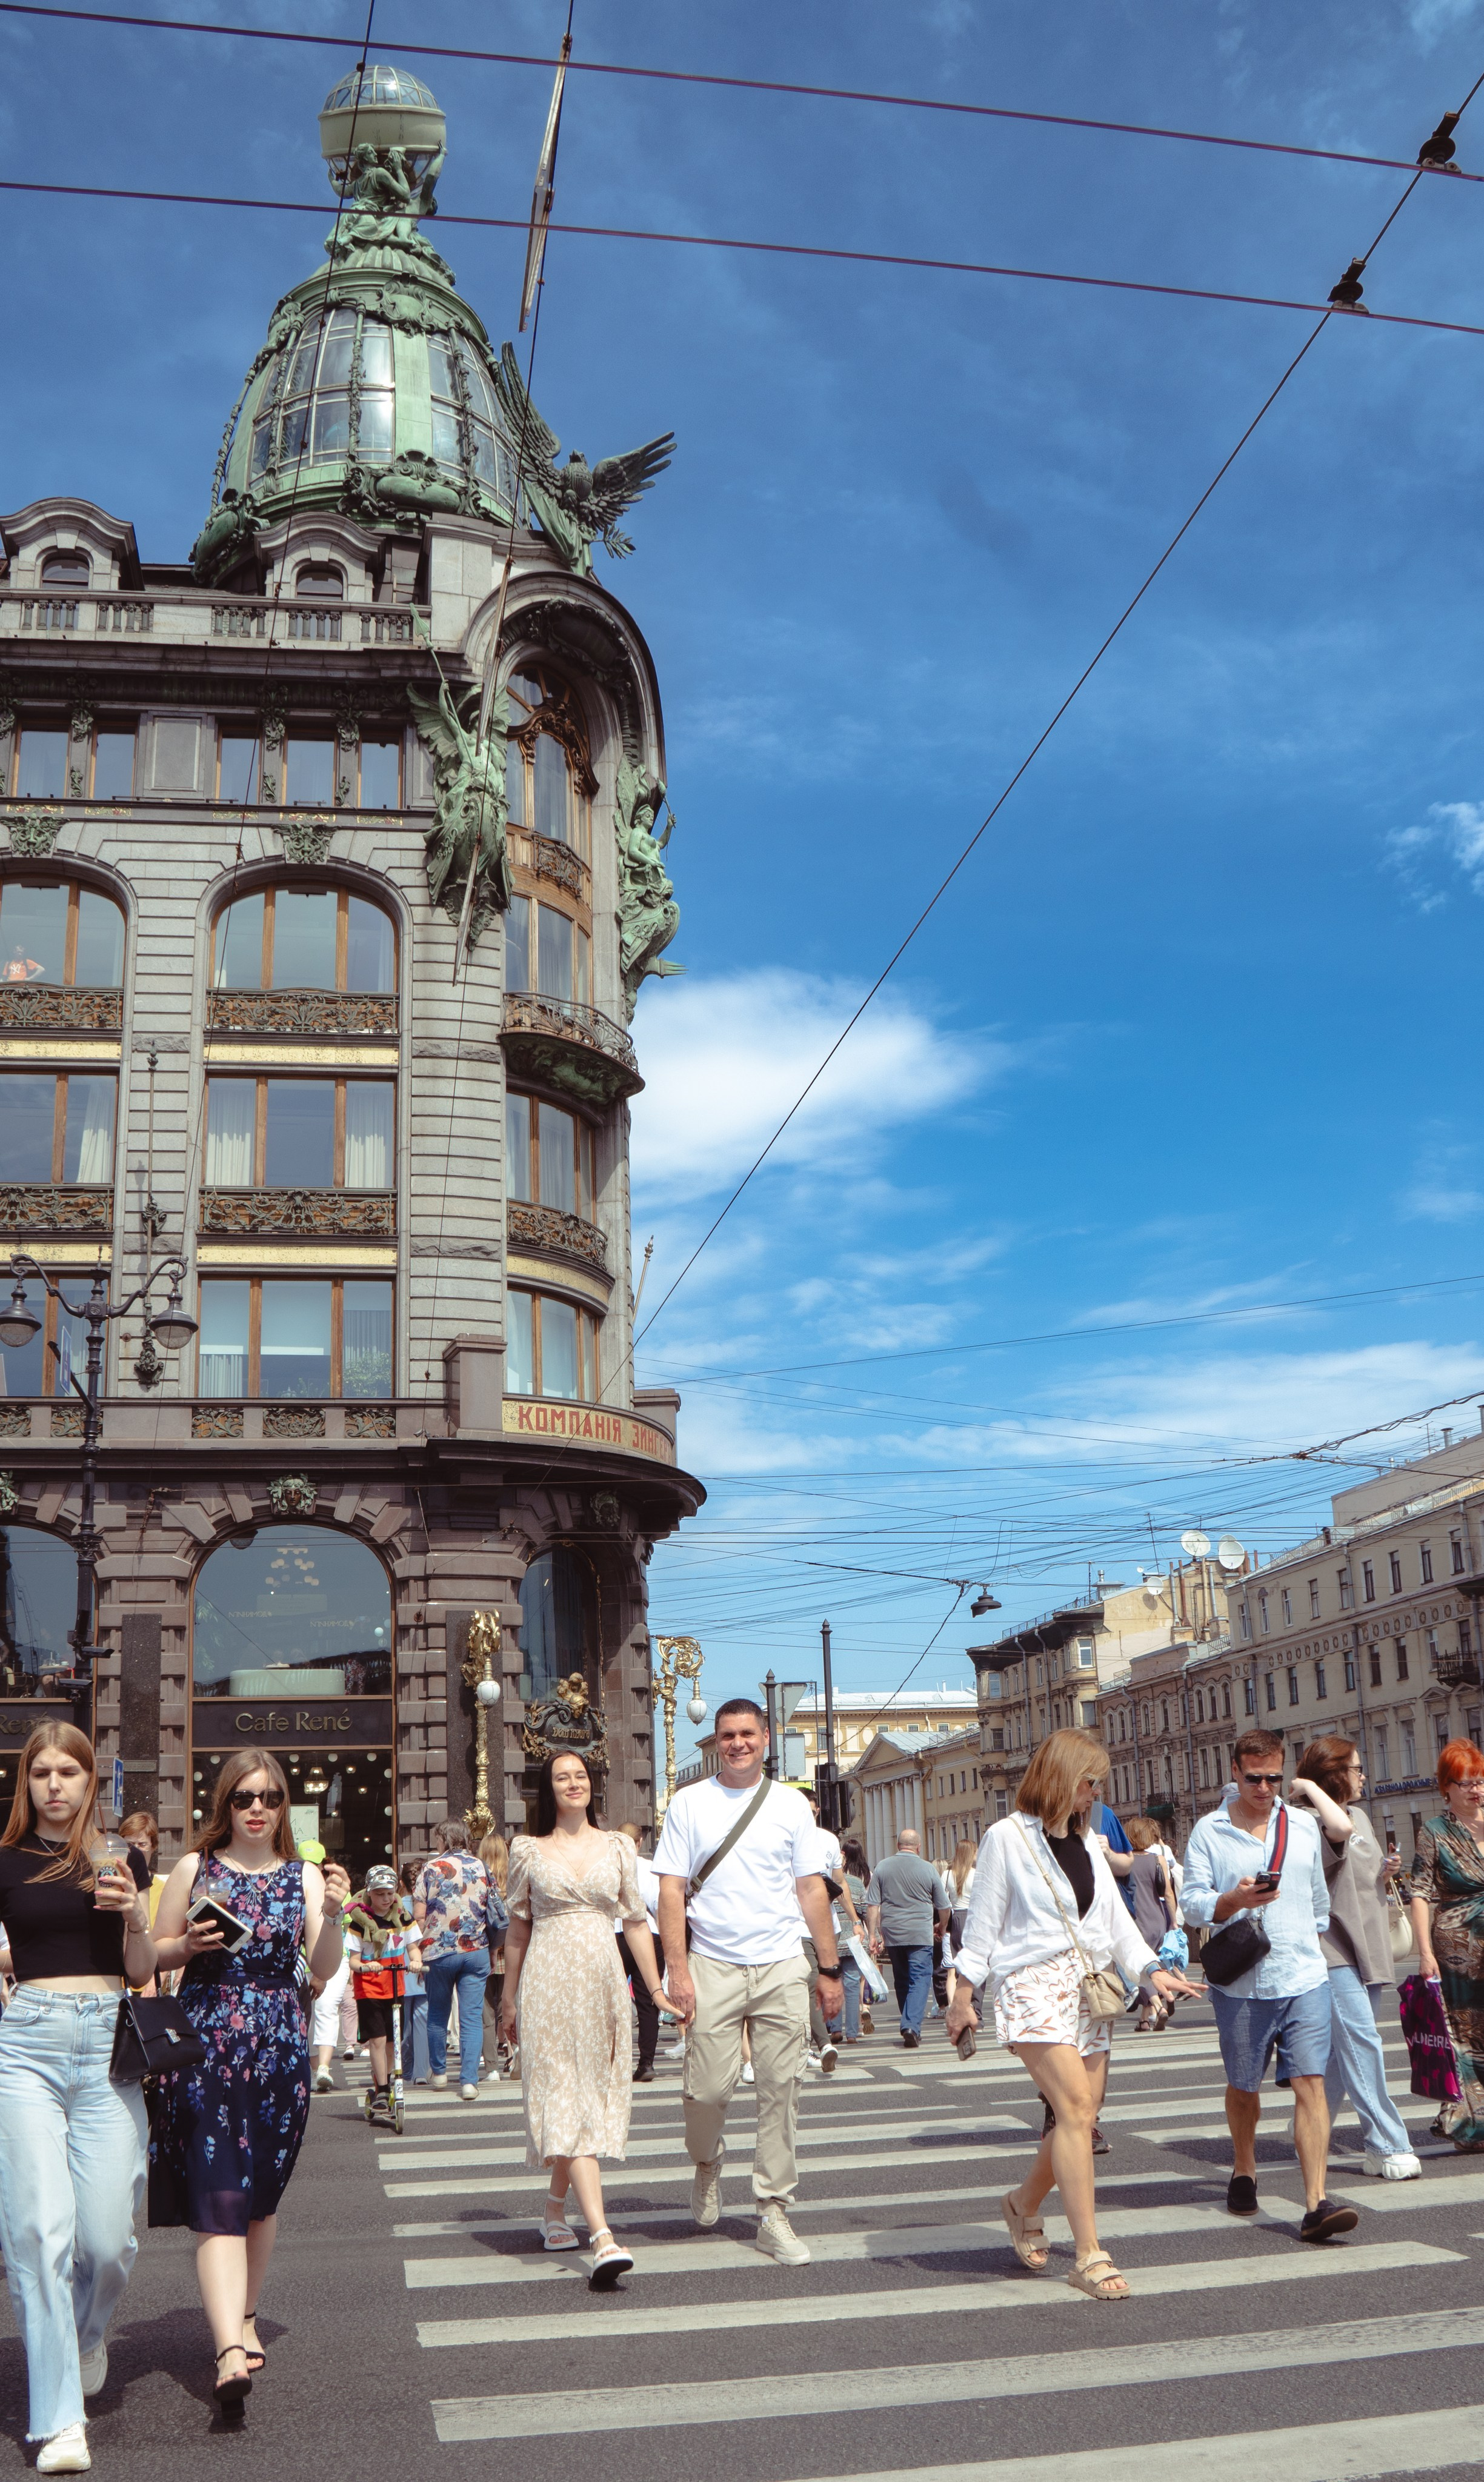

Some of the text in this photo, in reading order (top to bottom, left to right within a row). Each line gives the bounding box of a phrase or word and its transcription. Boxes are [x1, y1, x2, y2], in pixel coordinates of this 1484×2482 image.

[10, 963, 21, 974] NY
[519, 1405, 621, 1443] КОМПАНІЯ
[0, 1711, 52, 1734] Ren
[235, 1708, 353, 1732] Cafe René
